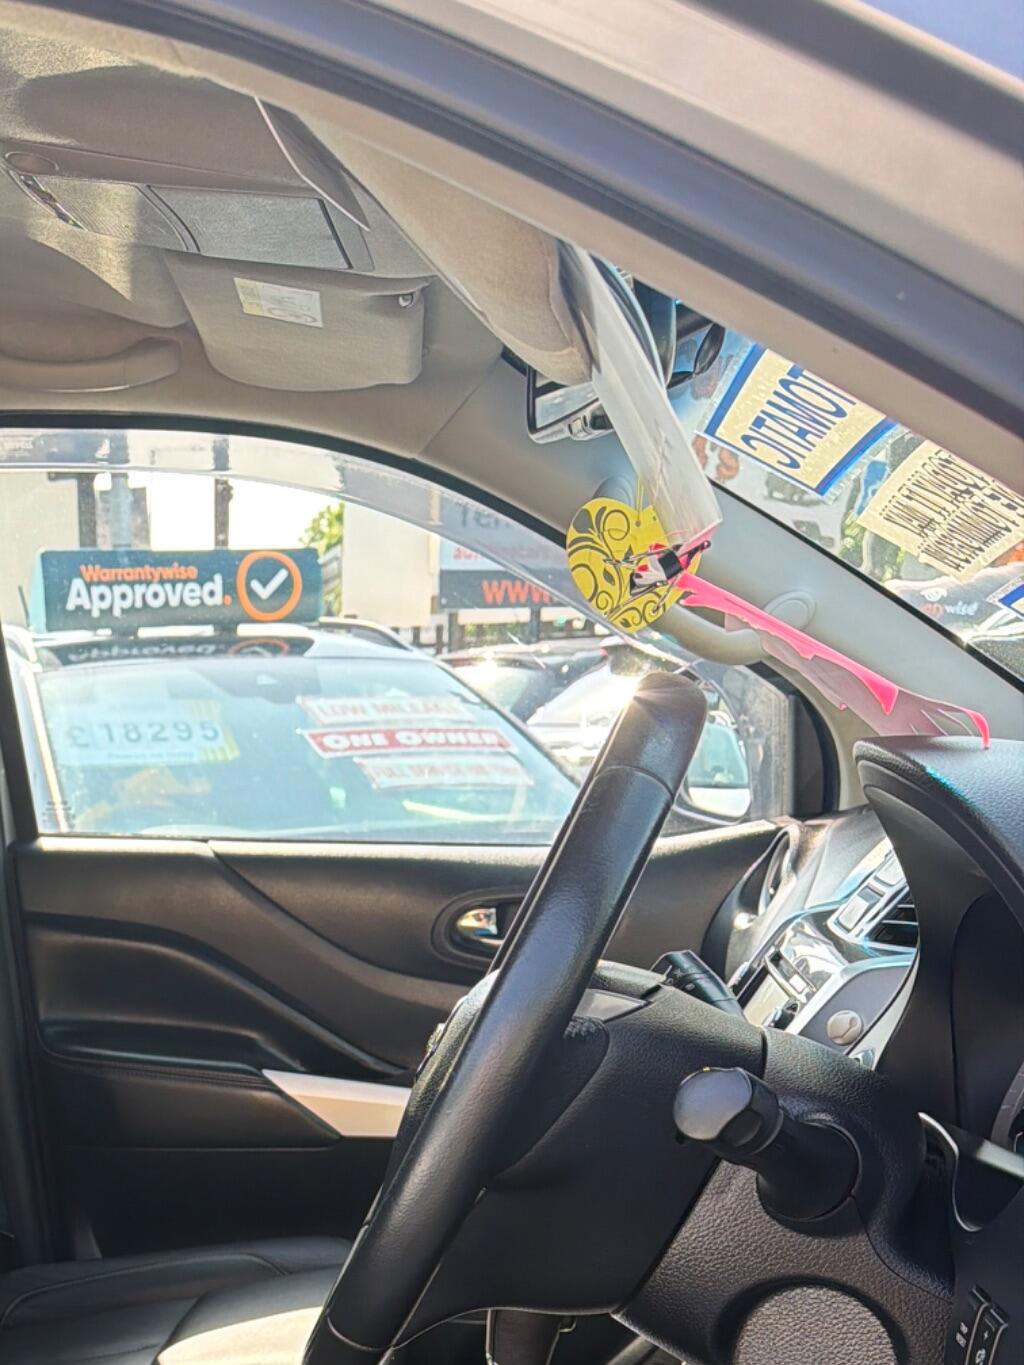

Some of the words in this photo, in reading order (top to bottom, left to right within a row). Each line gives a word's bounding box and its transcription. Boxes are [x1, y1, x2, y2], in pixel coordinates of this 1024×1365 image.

[80, 563, 198, 582] Warrantywise
[65, 573, 232, 617] Approved.
[323, 733, 387, 750] ONE
